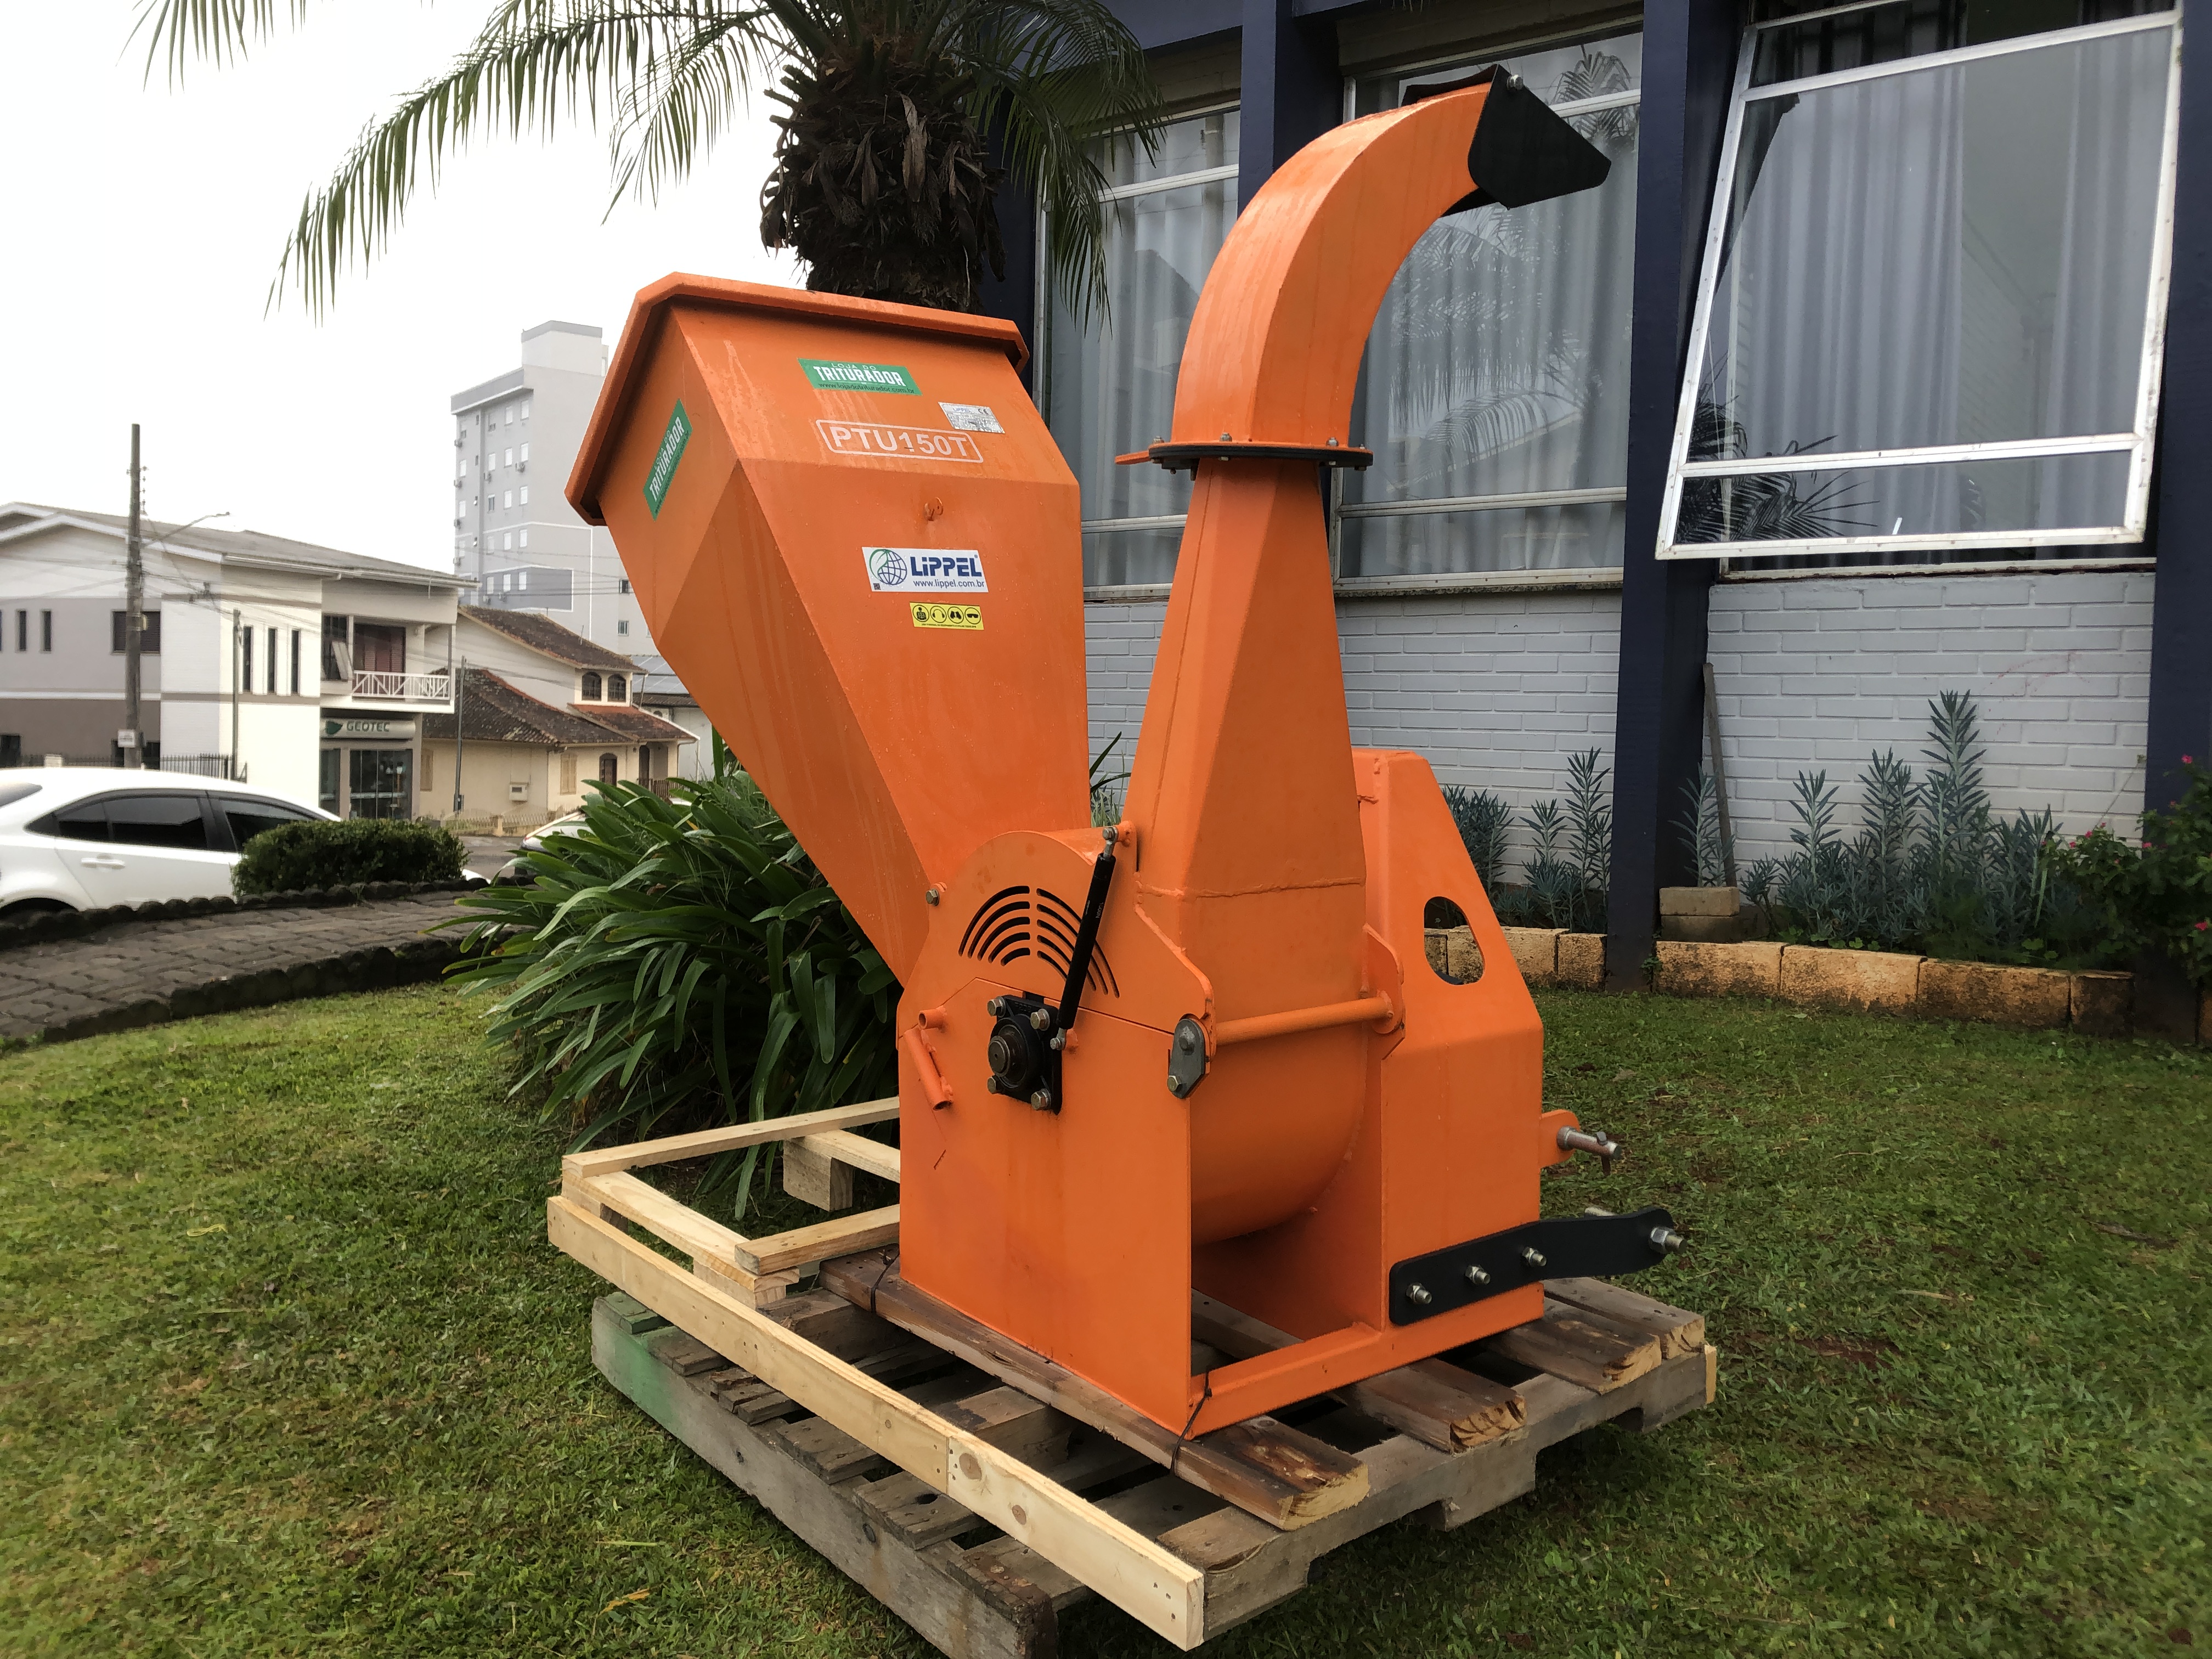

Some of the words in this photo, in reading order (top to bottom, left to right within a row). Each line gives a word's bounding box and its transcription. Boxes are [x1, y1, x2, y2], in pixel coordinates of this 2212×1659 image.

[813, 366, 907, 387] TRITURADOR
[829, 426, 968, 457] PTU150T
[650, 416, 685, 502] TRITURADOR
[913, 579, 985, 589] www.lippel.com.br
[346, 720, 391, 732] GEOTEC
